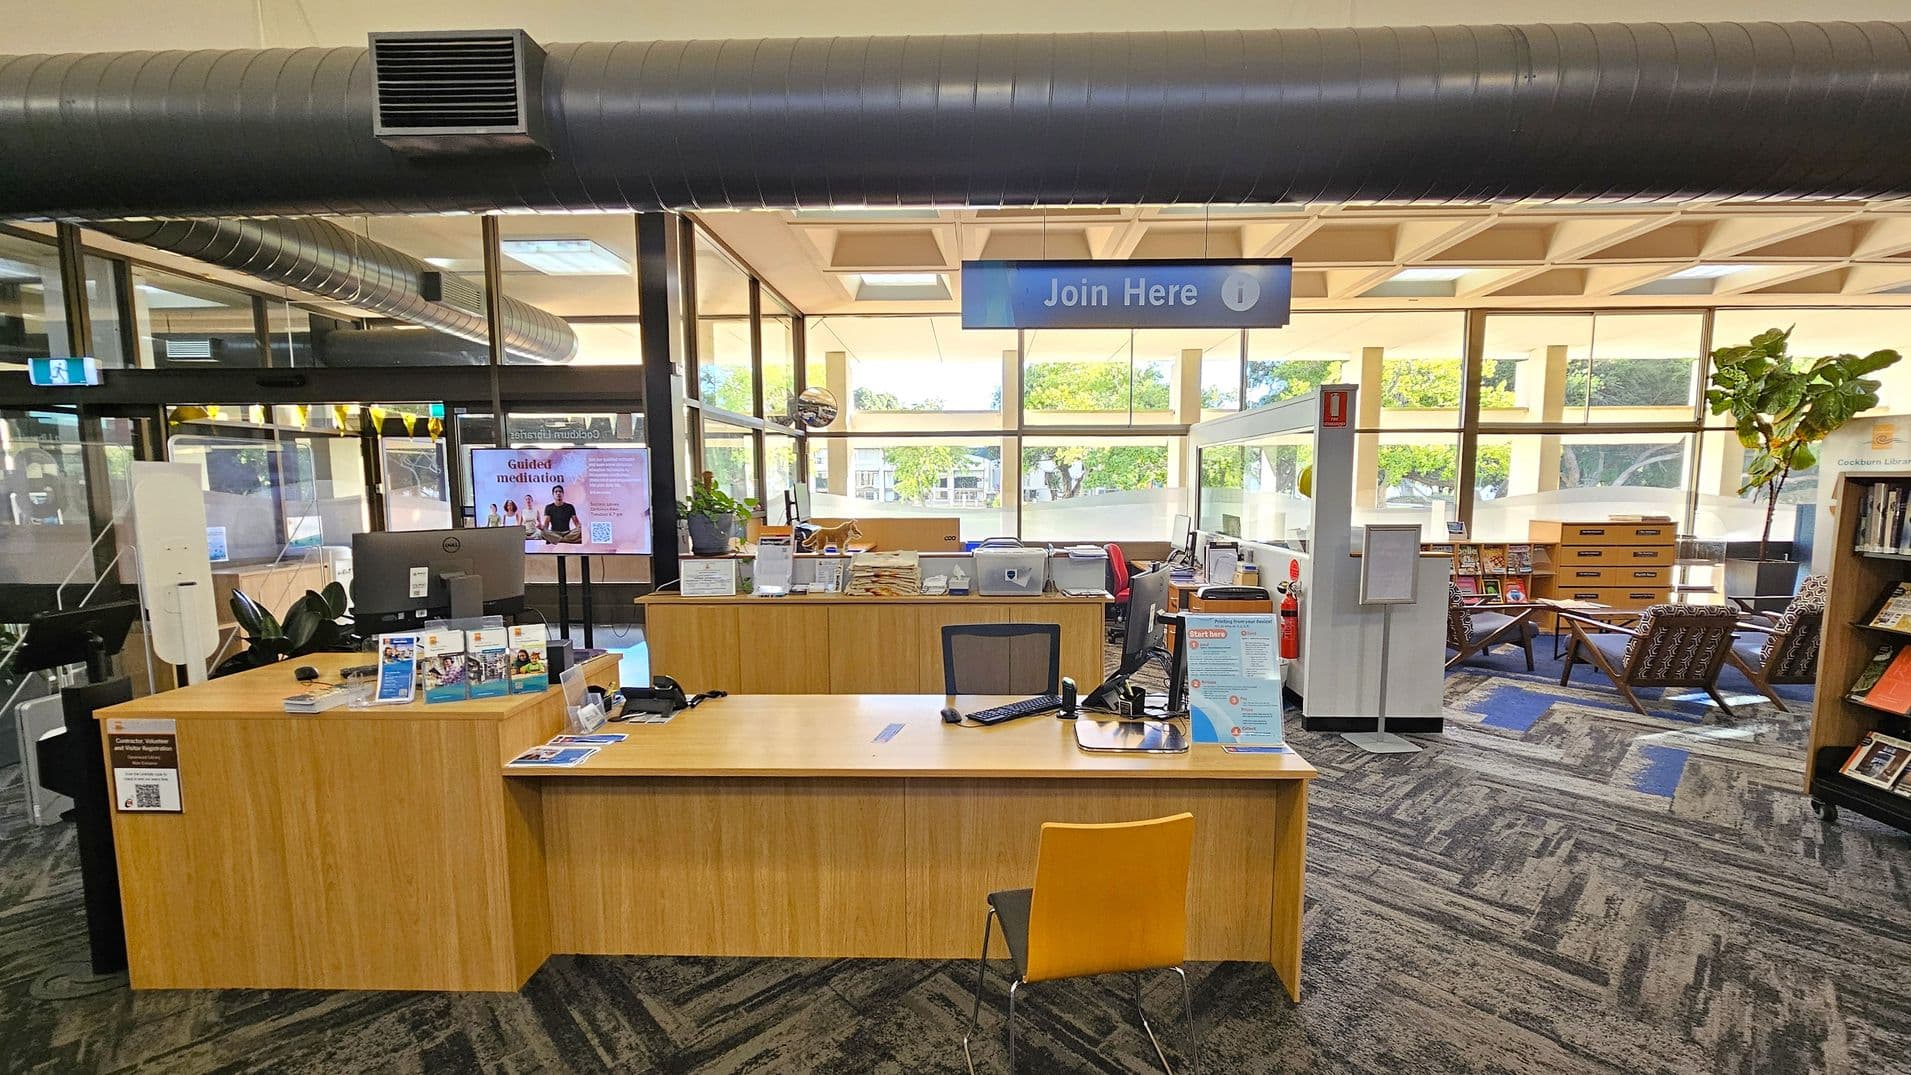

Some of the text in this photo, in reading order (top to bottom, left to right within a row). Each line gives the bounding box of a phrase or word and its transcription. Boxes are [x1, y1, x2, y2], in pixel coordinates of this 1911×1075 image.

[1044, 278, 1108, 307] Join
[1124, 278, 1198, 307] Here
[507, 459, 552, 470] Guided
[496, 472, 565, 484] meditation
[1189, 630, 1226, 638] Start here
